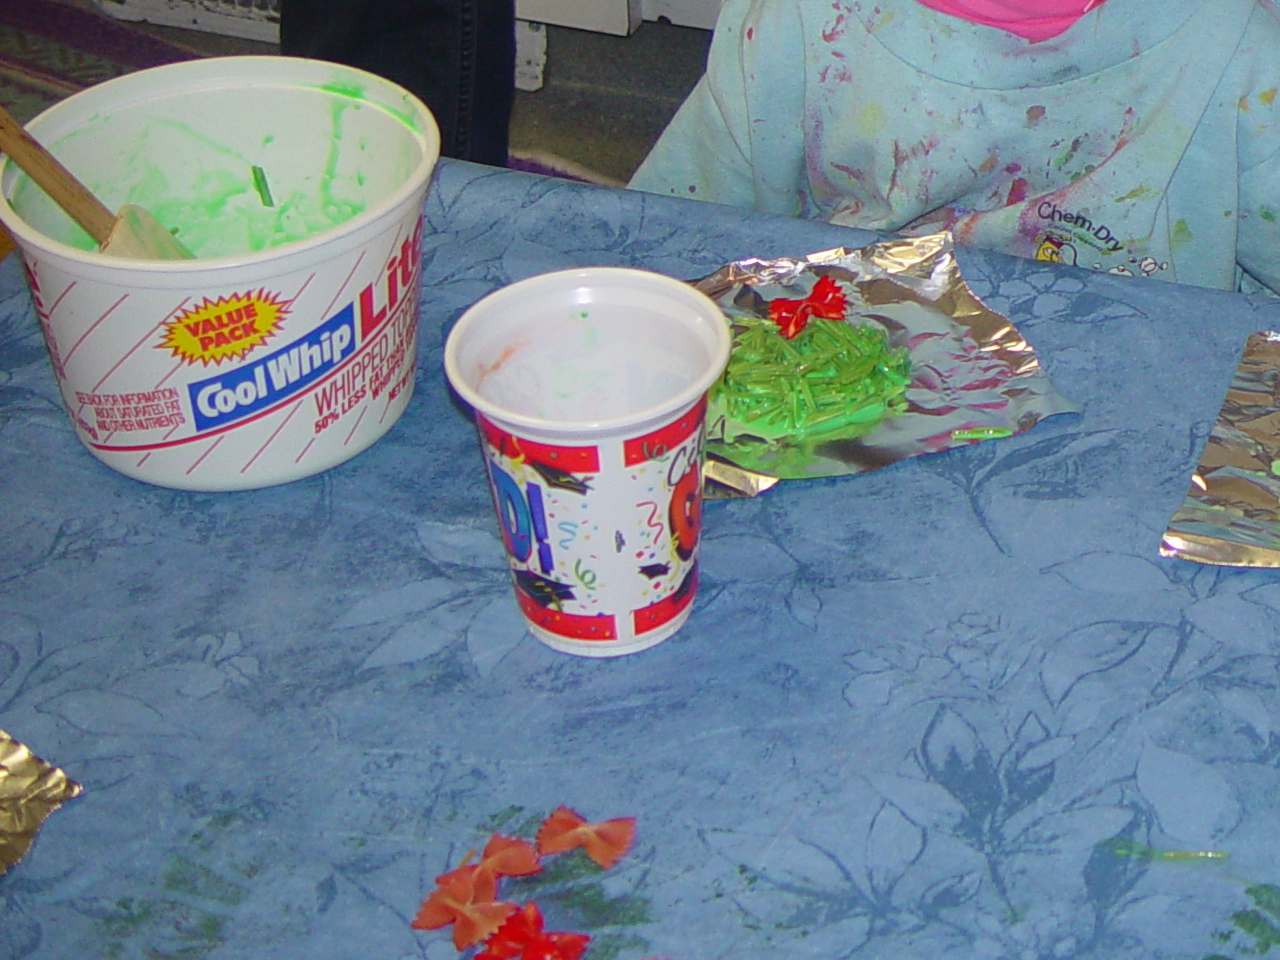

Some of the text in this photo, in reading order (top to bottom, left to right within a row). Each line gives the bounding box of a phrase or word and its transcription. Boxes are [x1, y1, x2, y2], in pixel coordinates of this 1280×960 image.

[183, 303, 258, 337] VALUE
[198, 319, 261, 352] PACK
[314, 332, 389, 417] WHIPPED
[117, 403, 164, 419] SATURATED
[164, 399, 181, 414] FAT
[119, 388, 178, 405] INFORMATION
[314, 408, 340, 434] 50%
[341, 383, 367, 416] LESS
[134, 412, 185, 431] NUTRIENTS
